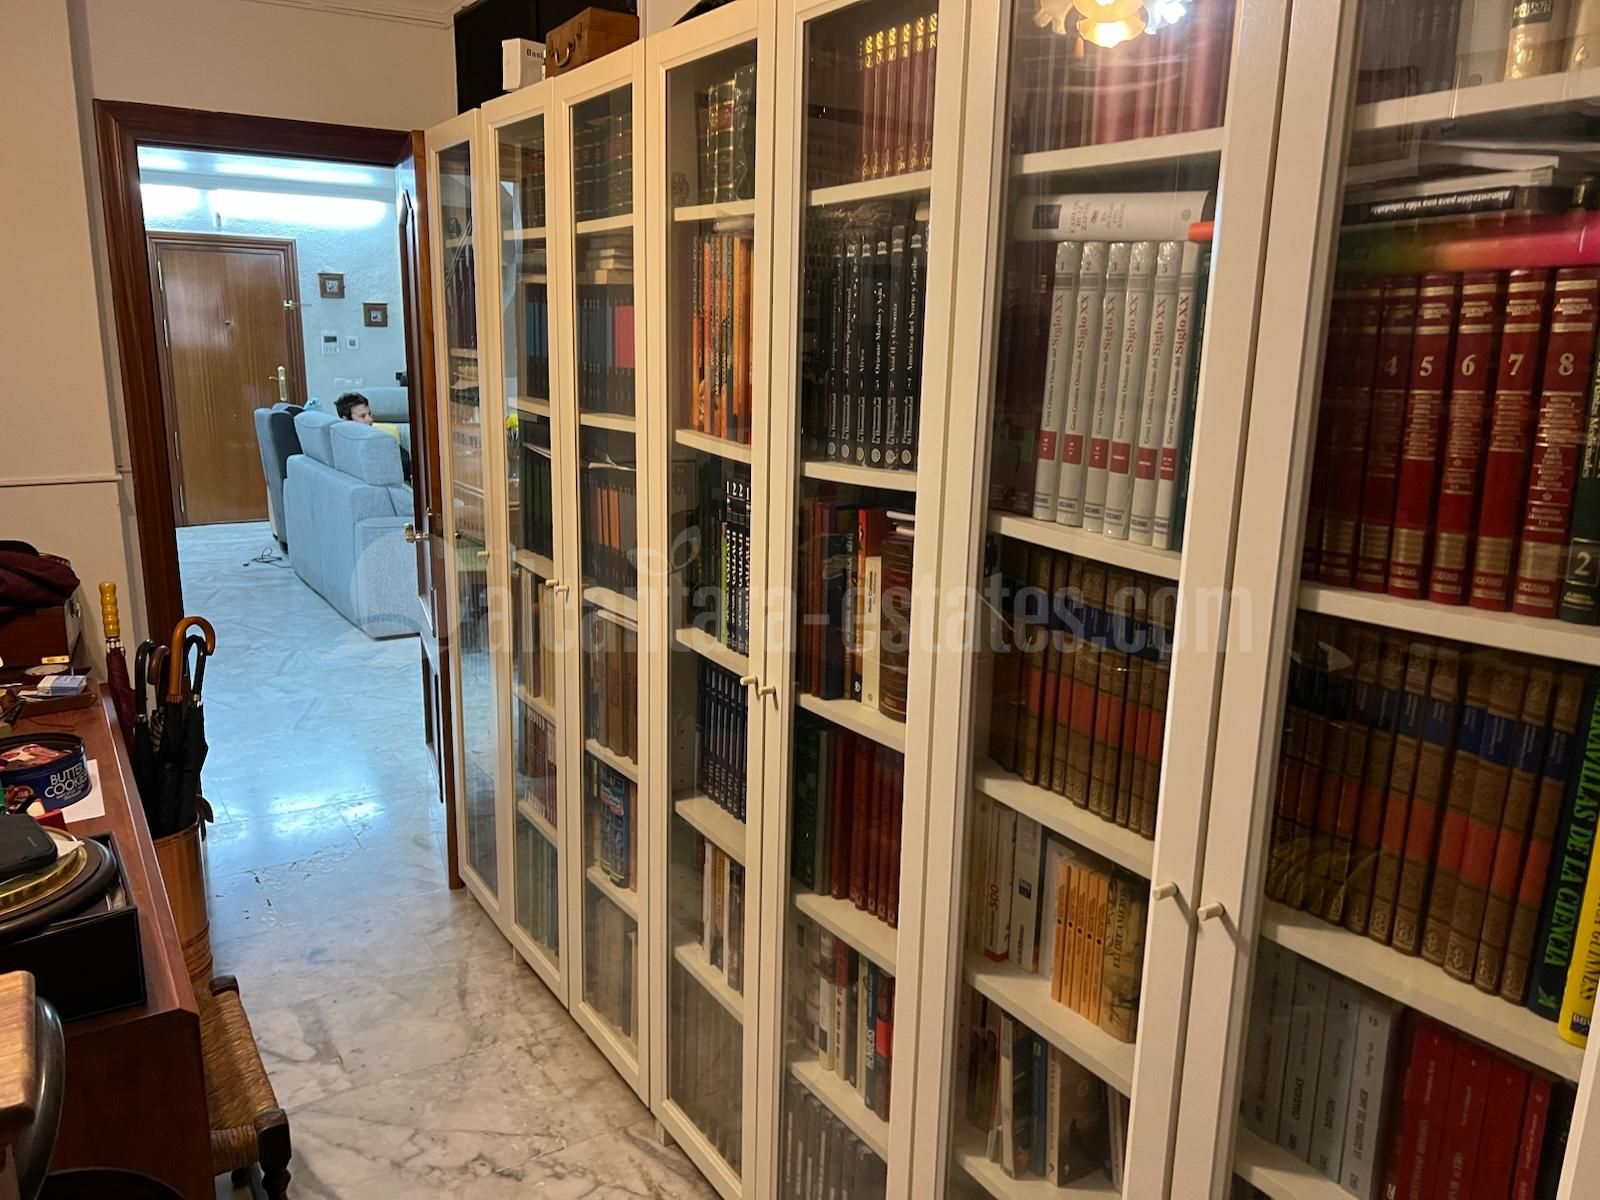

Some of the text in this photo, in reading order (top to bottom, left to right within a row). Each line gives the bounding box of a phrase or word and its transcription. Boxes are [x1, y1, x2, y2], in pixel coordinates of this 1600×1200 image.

[1422, 198, 1438, 209] una
[1438, 195, 1458, 207] para
[1085, 261, 1092, 271] 2
[1162, 264, 1168, 273] 5
[1054, 294, 1064, 313] XX
[1080, 295, 1089, 315] XX
[1105, 296, 1116, 316] XX
[1127, 296, 1138, 318] XX
[1155, 299, 1166, 321] XX
[1178, 296, 1189, 318] XX
[1051, 315, 1062, 346] Siglo
[1077, 317, 1088, 348] Siglo
[1103, 318, 1114, 351] Siglo
[1125, 320, 1136, 352] Siglo
[1152, 324, 1165, 356] Siglo
[1175, 322, 1188, 354] Siglo
[1383, 356, 1398, 375] 4
[1419, 356, 1435, 376] 5
[1460, 354, 1477, 376] 6
[1508, 353, 1524, 376] 7
[1558, 352, 1575, 376] 8
[1574, 551, 1592, 576] 2
[1518, 582, 1550, 595] OCEANO
[1567, 823, 1593, 850] DE
[1560, 852, 1588, 885] LA
[1544, 888, 1581, 968] CIENCIA
